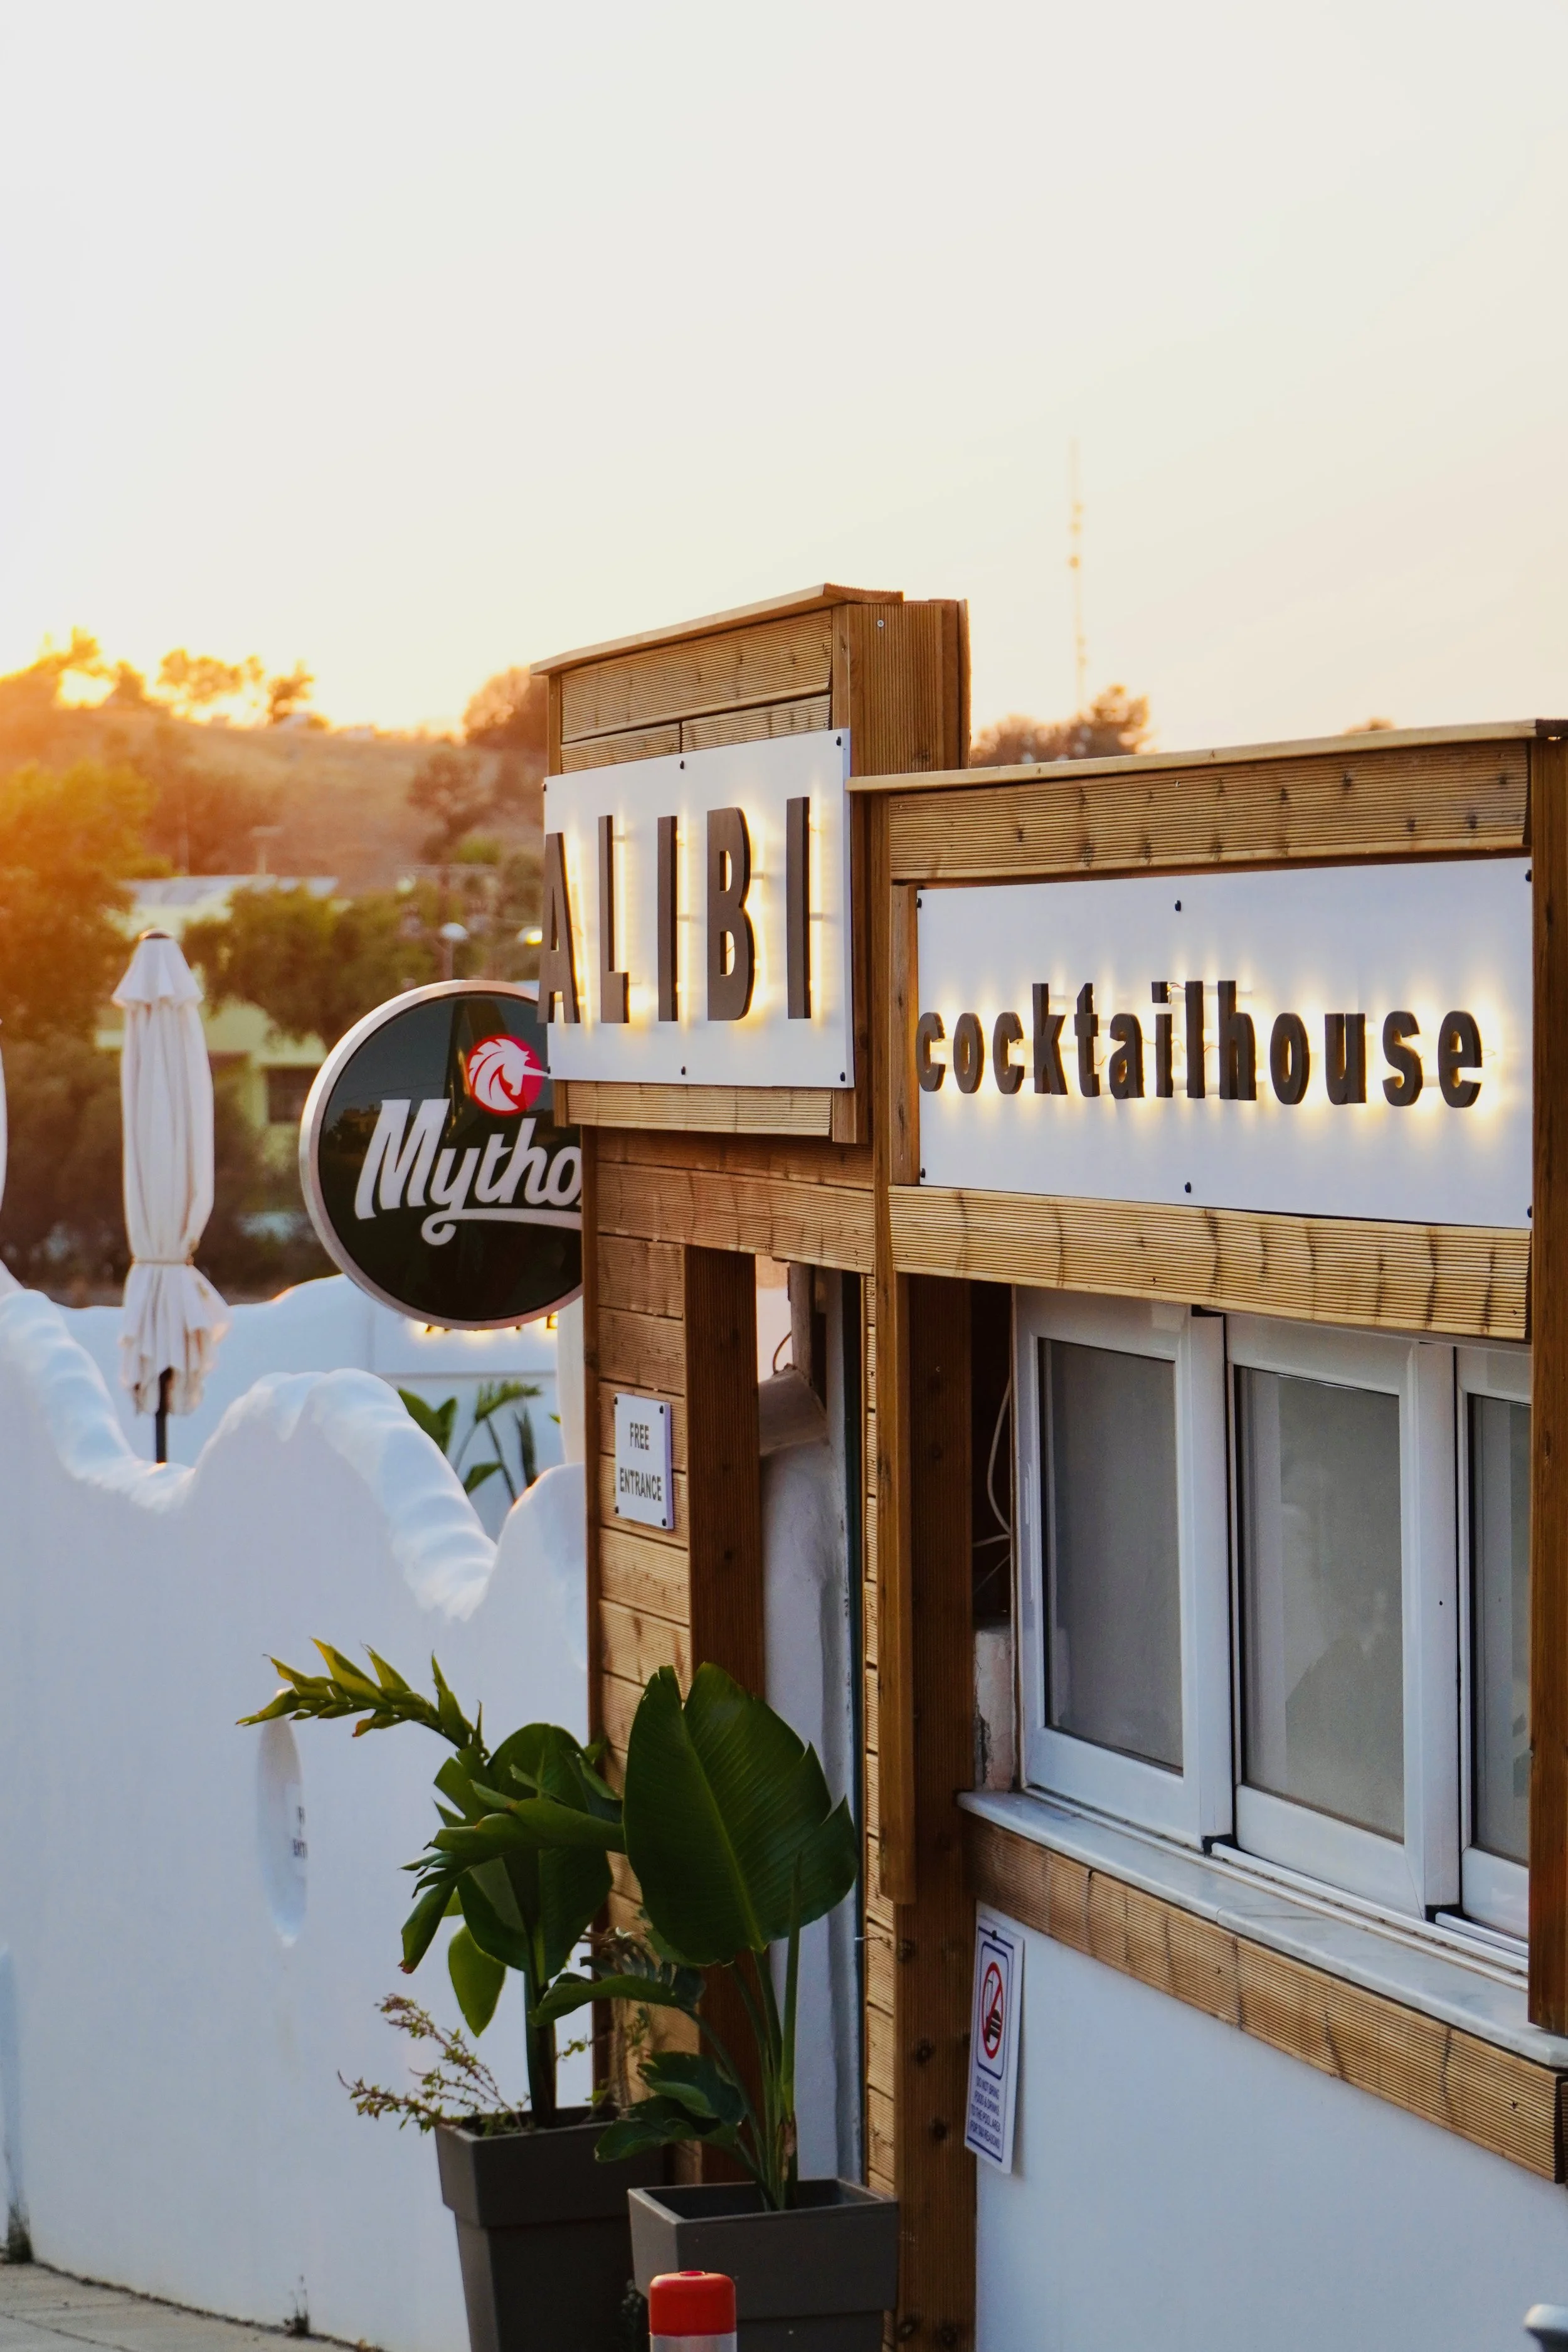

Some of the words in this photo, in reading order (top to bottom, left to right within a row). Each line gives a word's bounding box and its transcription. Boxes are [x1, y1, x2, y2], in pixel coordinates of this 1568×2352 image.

[538, 797, 811, 1024] ALIBI
[916, 980, 1482, 1108] cocktailhouse
[354, 1098, 582, 1245] Mytho
[620, 1467, 662, 1502] ENTRANCE
[630, 1422, 649, 1450] FREE
